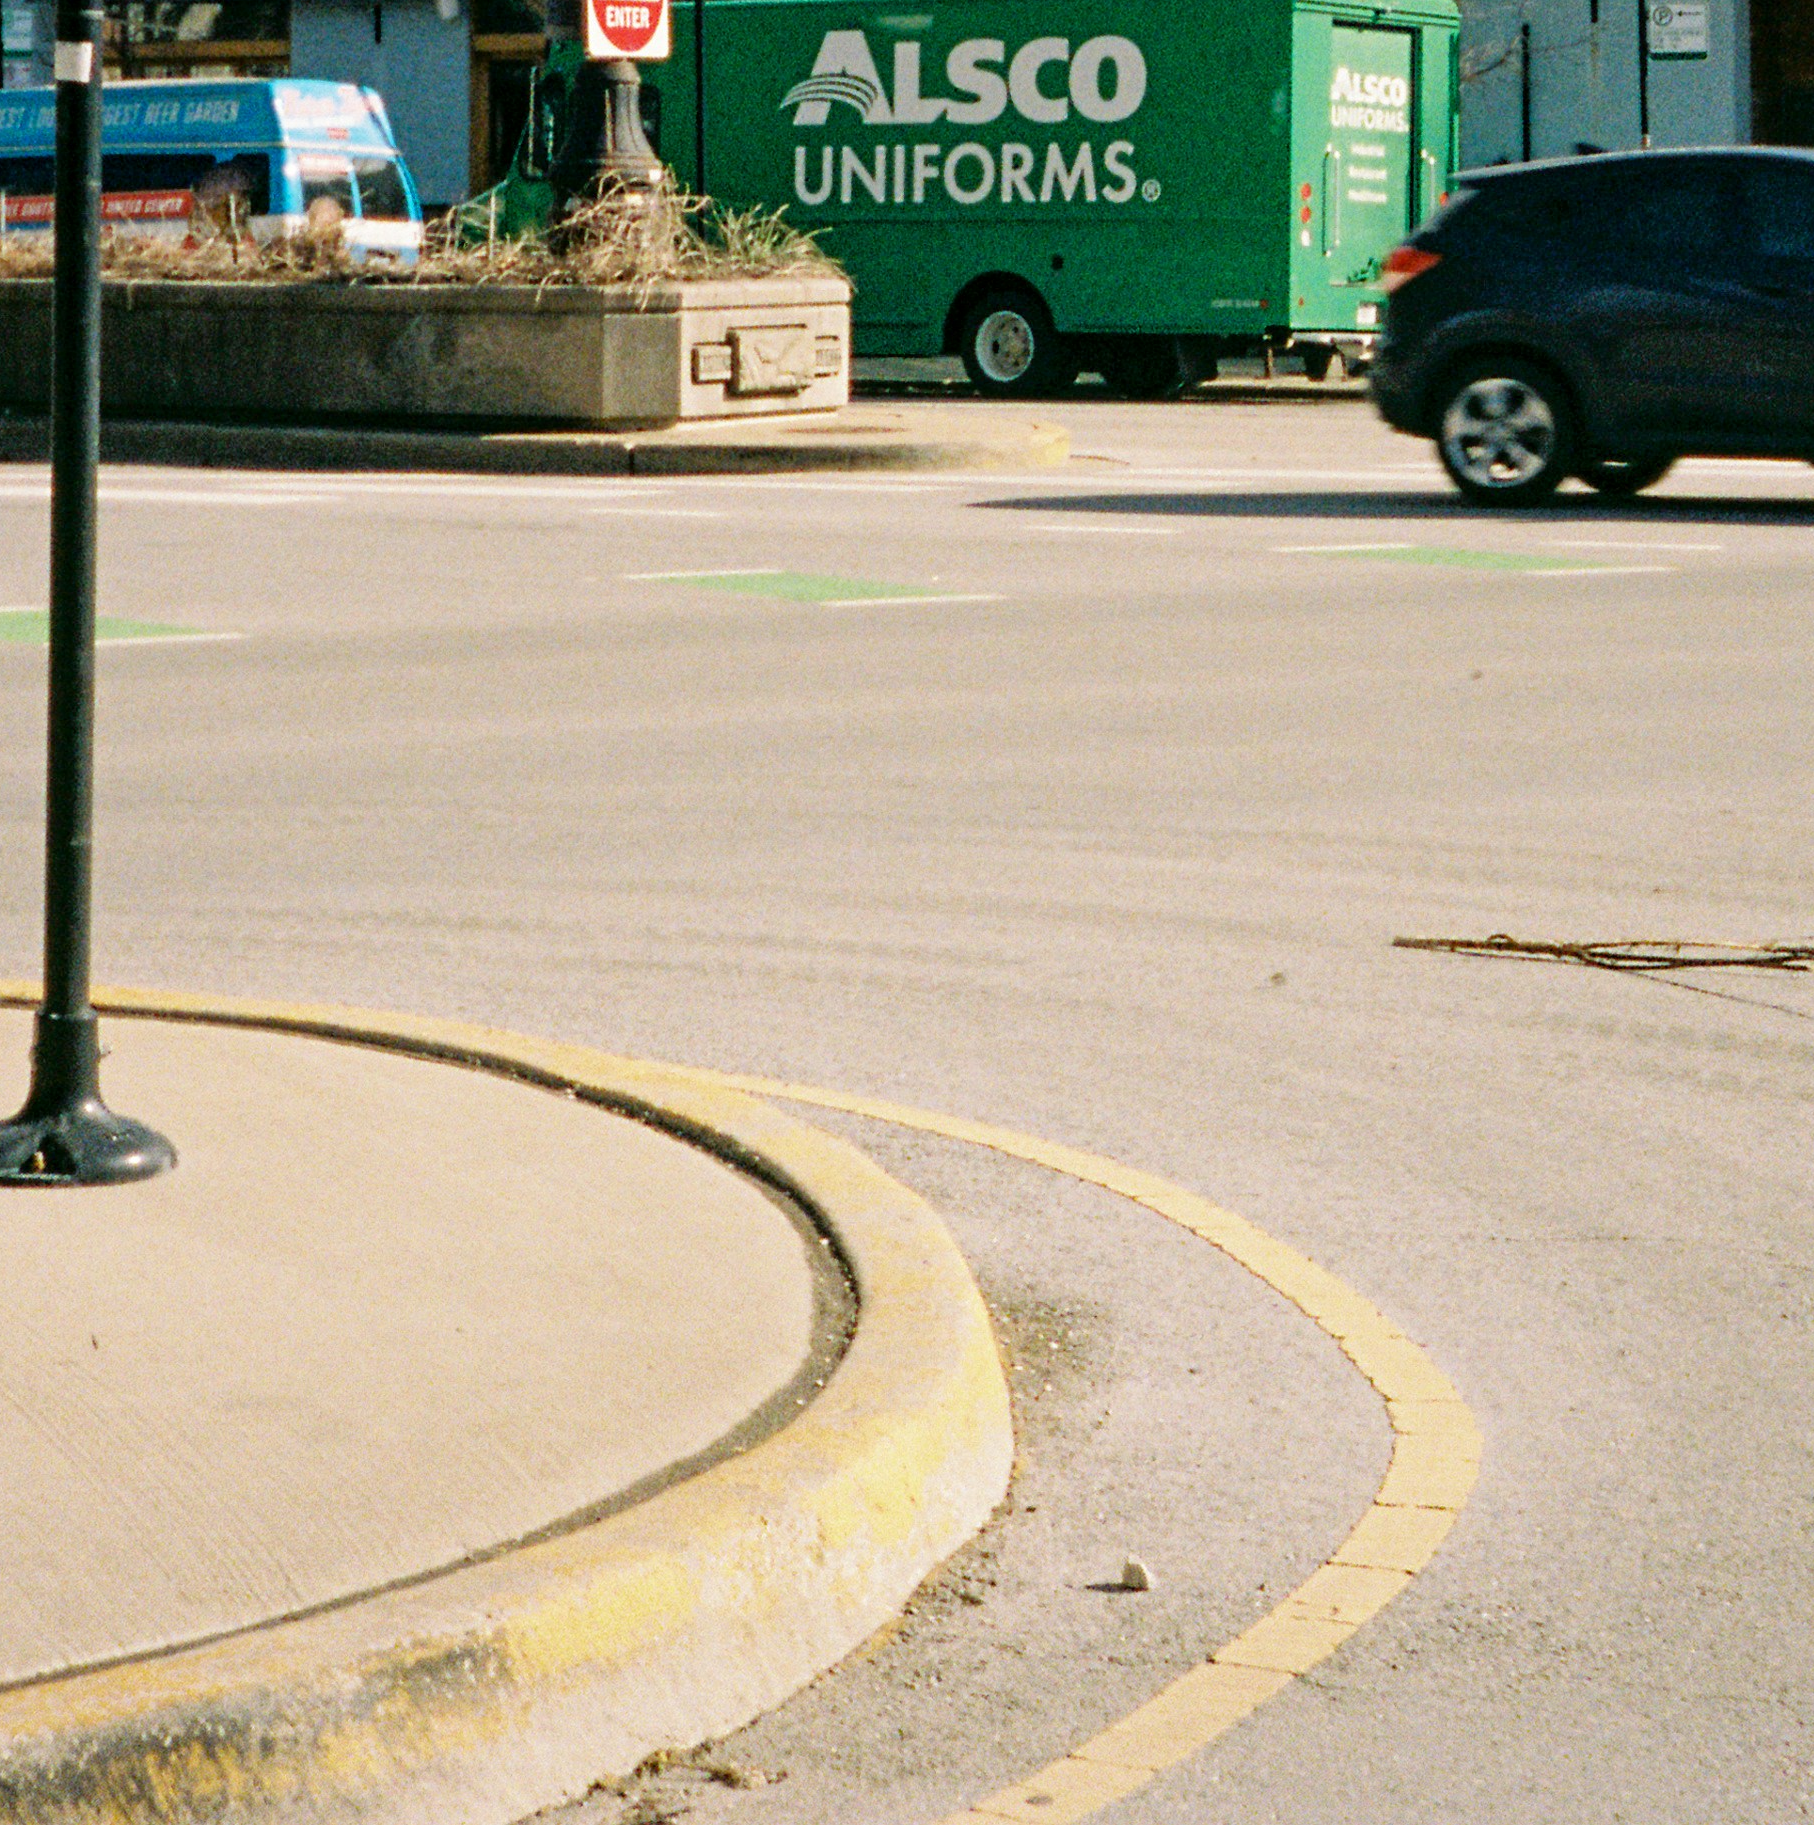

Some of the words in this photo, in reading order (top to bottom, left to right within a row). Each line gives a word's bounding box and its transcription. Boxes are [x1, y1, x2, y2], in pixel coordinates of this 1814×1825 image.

[605, 5, 650, 29] ENTER
[779, 30, 1147, 127] ALSCO
[1331, 65, 1407, 107] ALSCO
